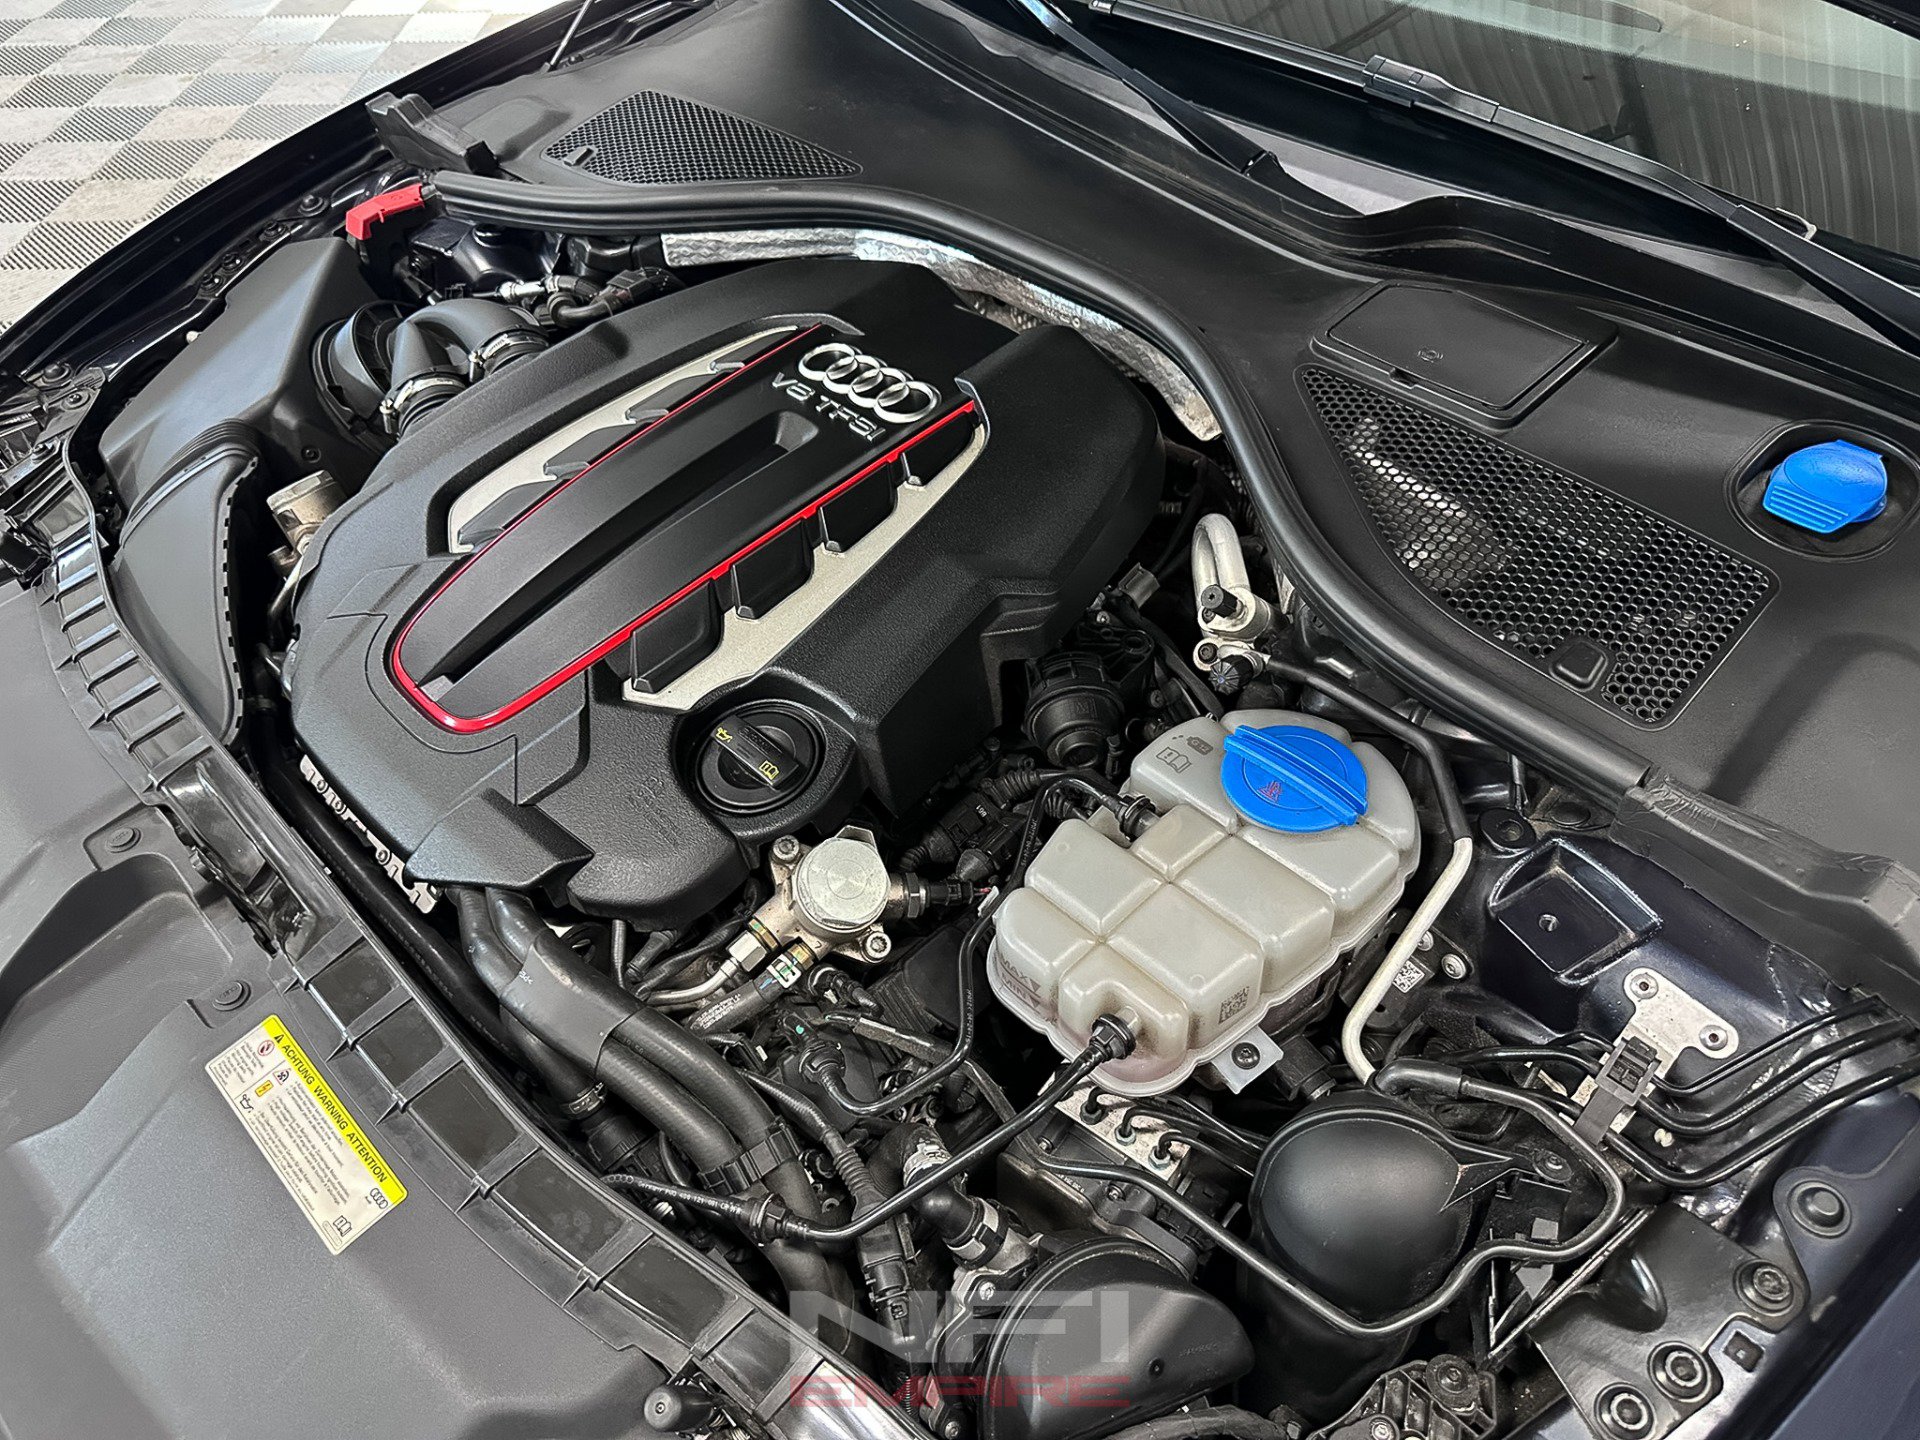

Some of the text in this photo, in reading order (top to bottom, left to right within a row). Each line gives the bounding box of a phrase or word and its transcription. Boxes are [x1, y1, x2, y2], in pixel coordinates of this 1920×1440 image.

[772, 372, 886, 442] V8 TFSI
[1001, 952, 1029, 984] MAX
[1001, 971, 1027, 999] MIN
[281, 1044, 316, 1086] ACHTUNG
[313, 1085, 349, 1131] WARNING
[346, 1132, 388, 1184] ATTENTION
